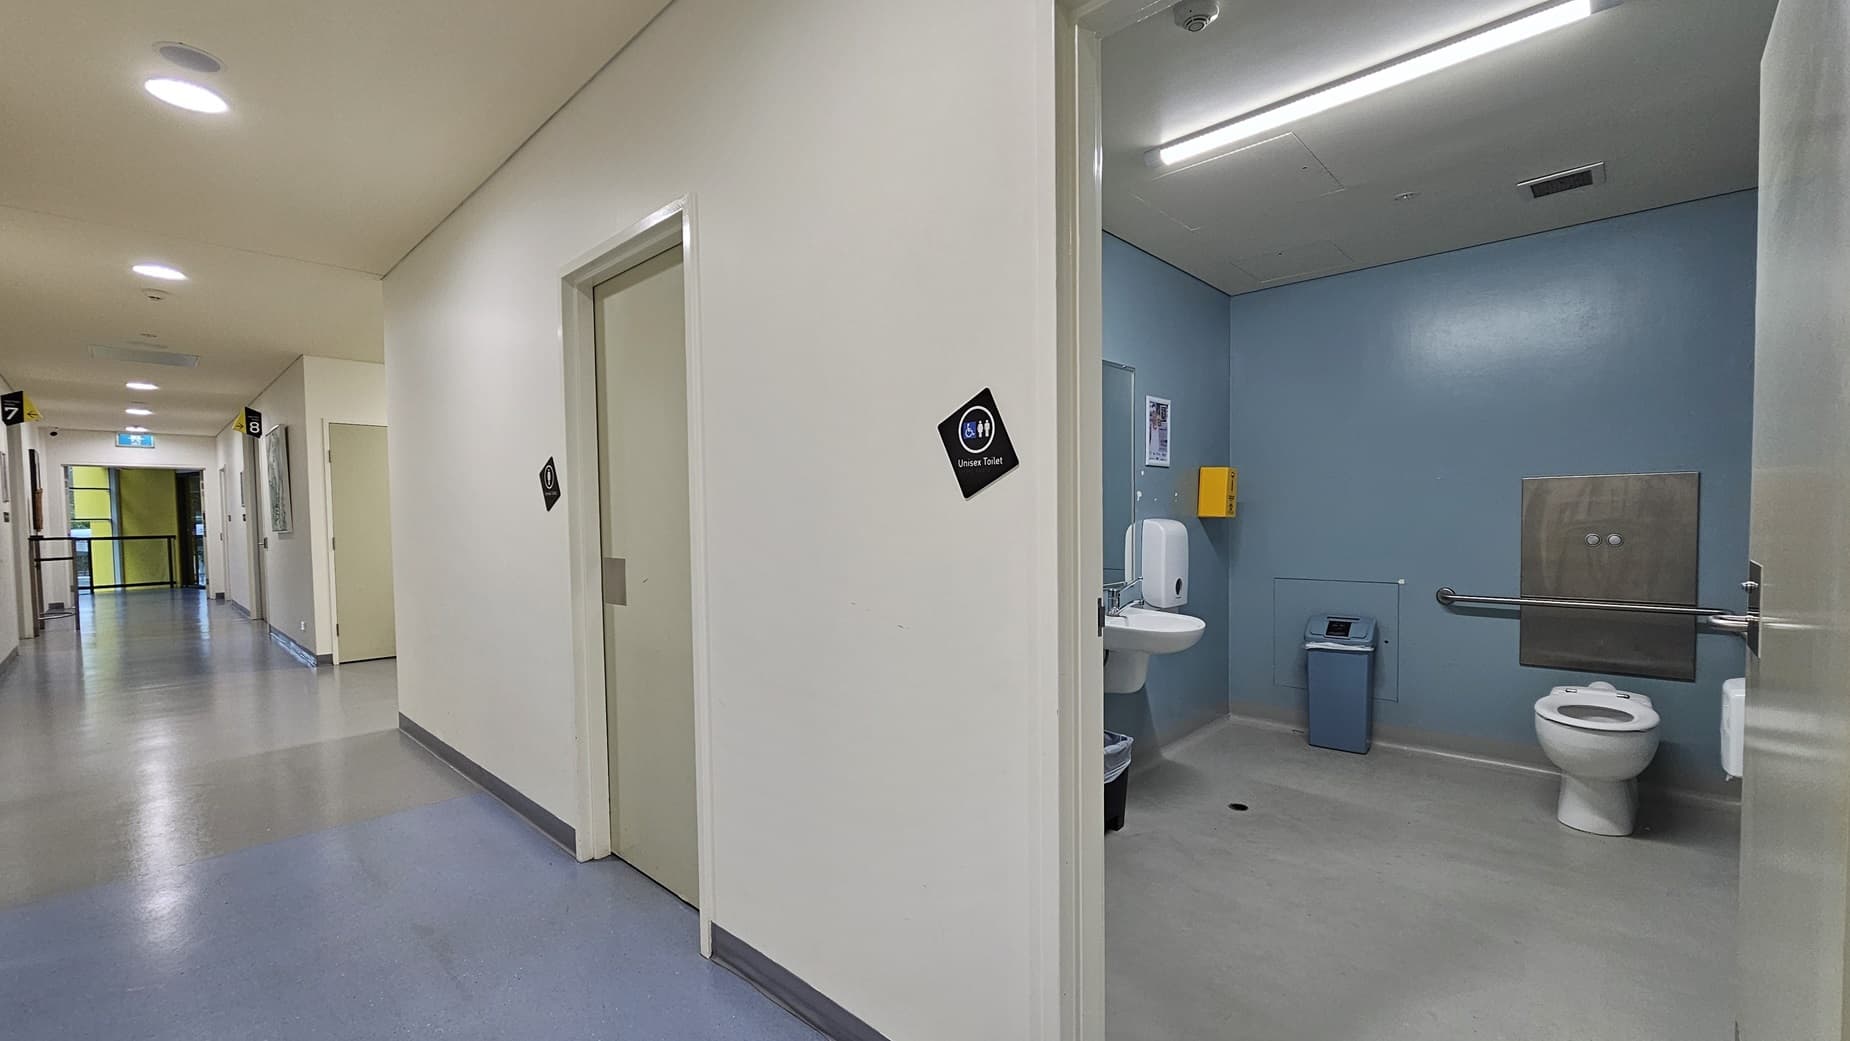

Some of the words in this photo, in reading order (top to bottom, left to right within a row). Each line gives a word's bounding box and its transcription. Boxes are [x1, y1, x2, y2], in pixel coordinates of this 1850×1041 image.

[4, 407, 19, 420] 7
[249, 421, 260, 433] 8
[957, 458, 981, 468] Unisex
[983, 456, 1003, 466] Toilet
